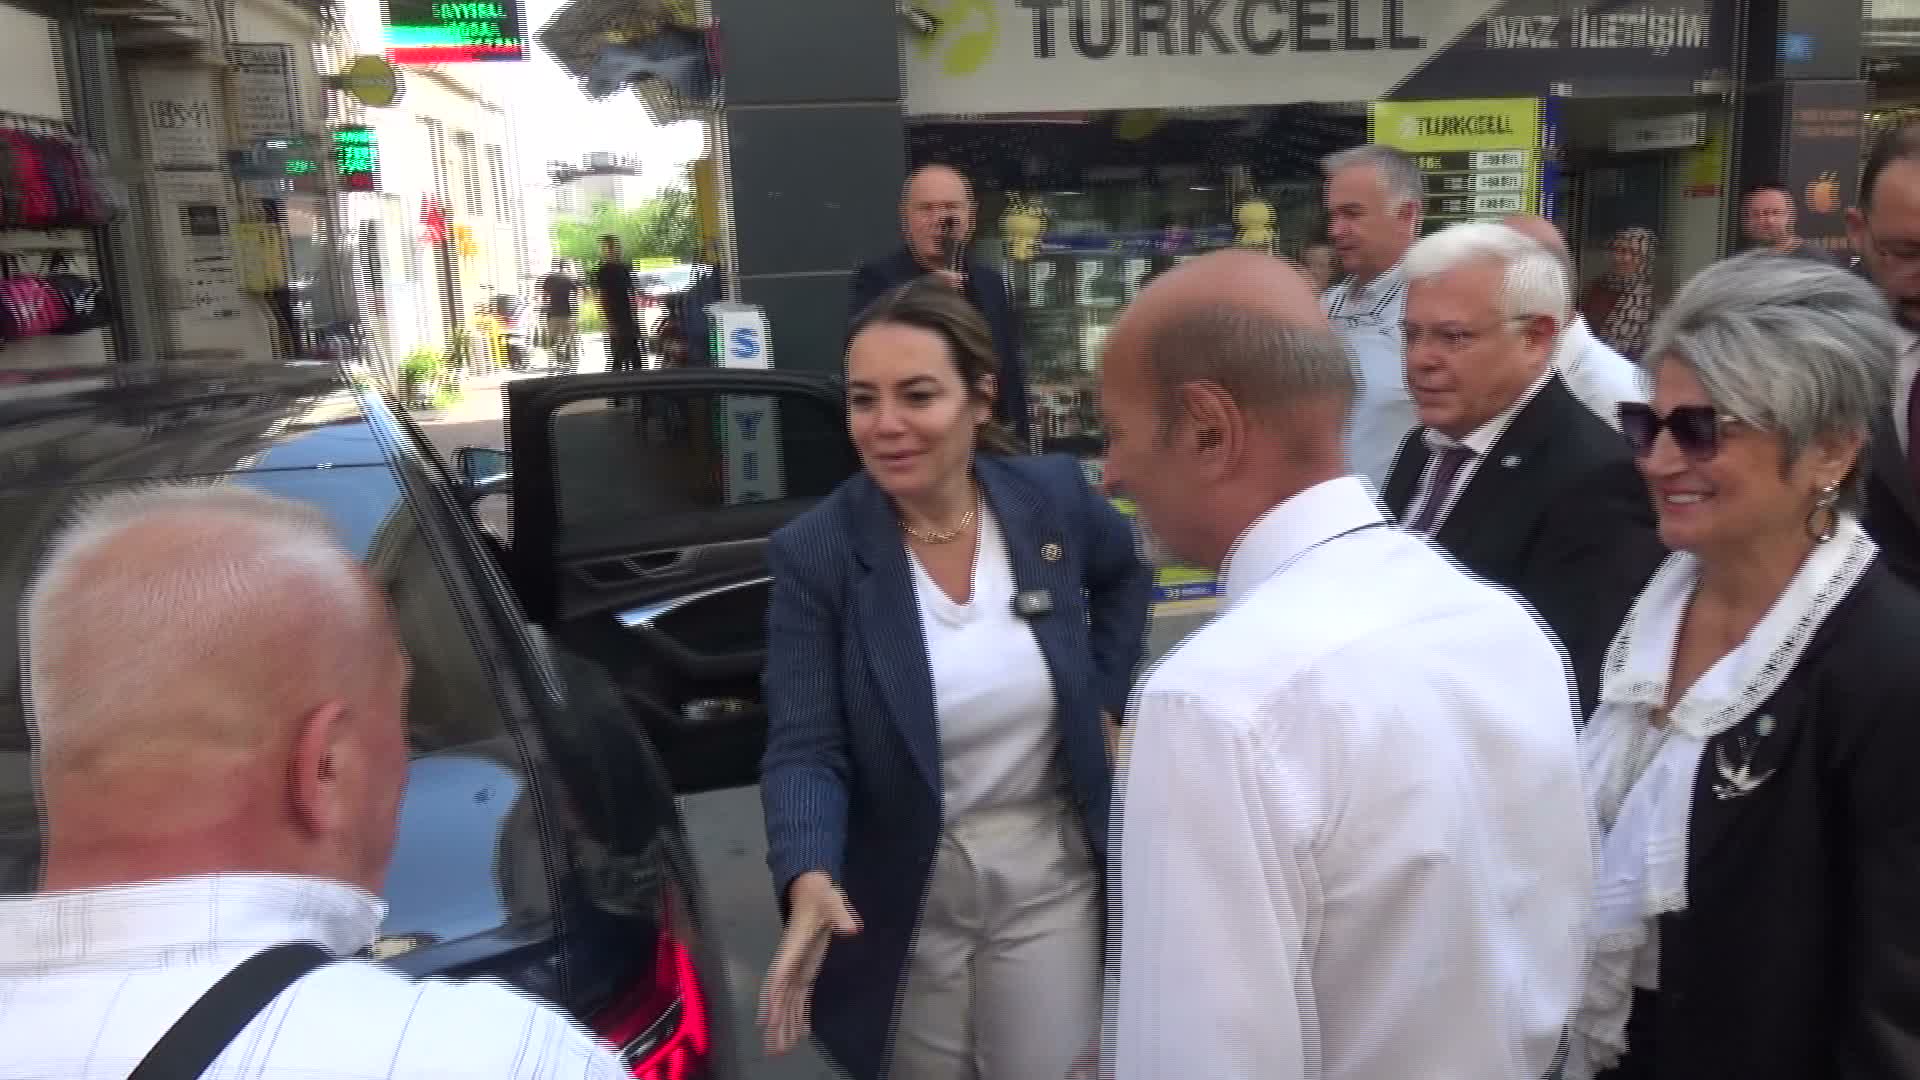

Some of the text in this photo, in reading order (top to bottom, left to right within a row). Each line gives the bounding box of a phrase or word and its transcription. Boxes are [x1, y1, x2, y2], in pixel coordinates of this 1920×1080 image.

[1015, 0, 1427, 59] TURKCELL
[1485, 7, 1711, 55] NAZ İLETİŞİM
[1416, 114, 1514, 136] TURKCELL
